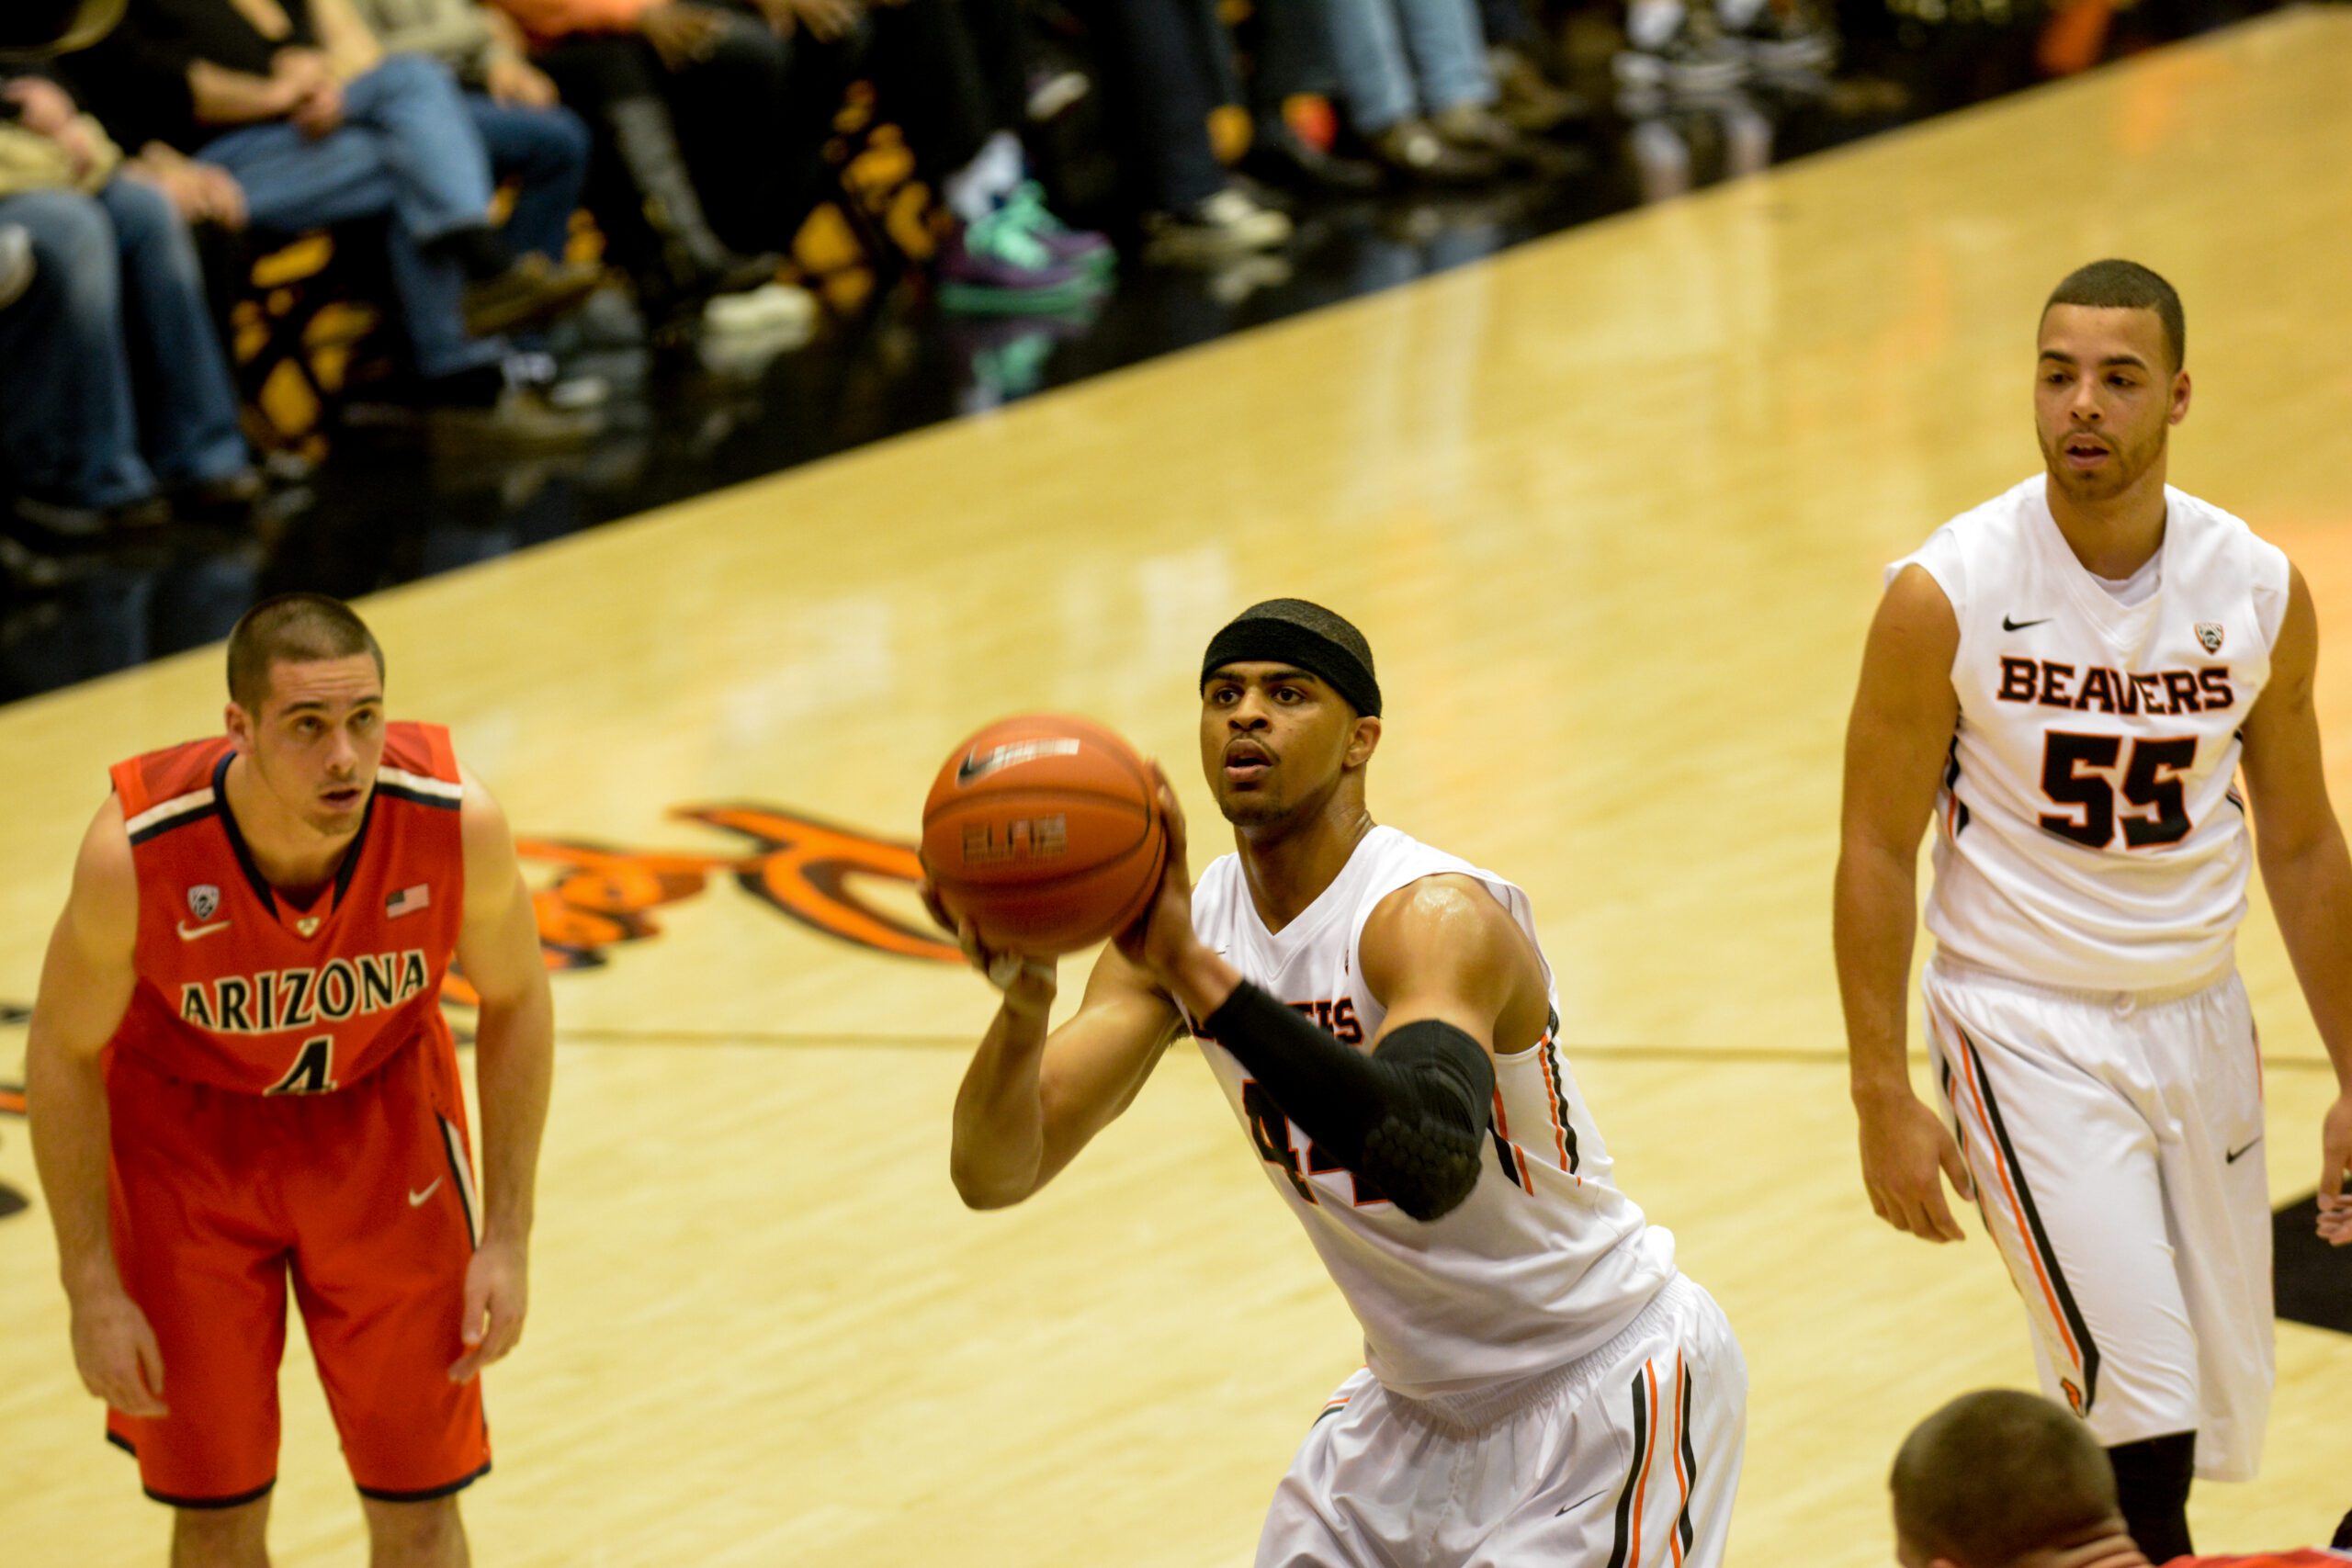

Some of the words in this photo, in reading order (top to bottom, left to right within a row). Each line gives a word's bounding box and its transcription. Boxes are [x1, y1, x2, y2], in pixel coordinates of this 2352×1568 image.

[1996, 655, 2234, 716] BEAVERS
[2038, 729, 2199, 850] 55
[180, 949, 429, 1035] ARIZONA
[262, 1034, 338, 1097] 4
